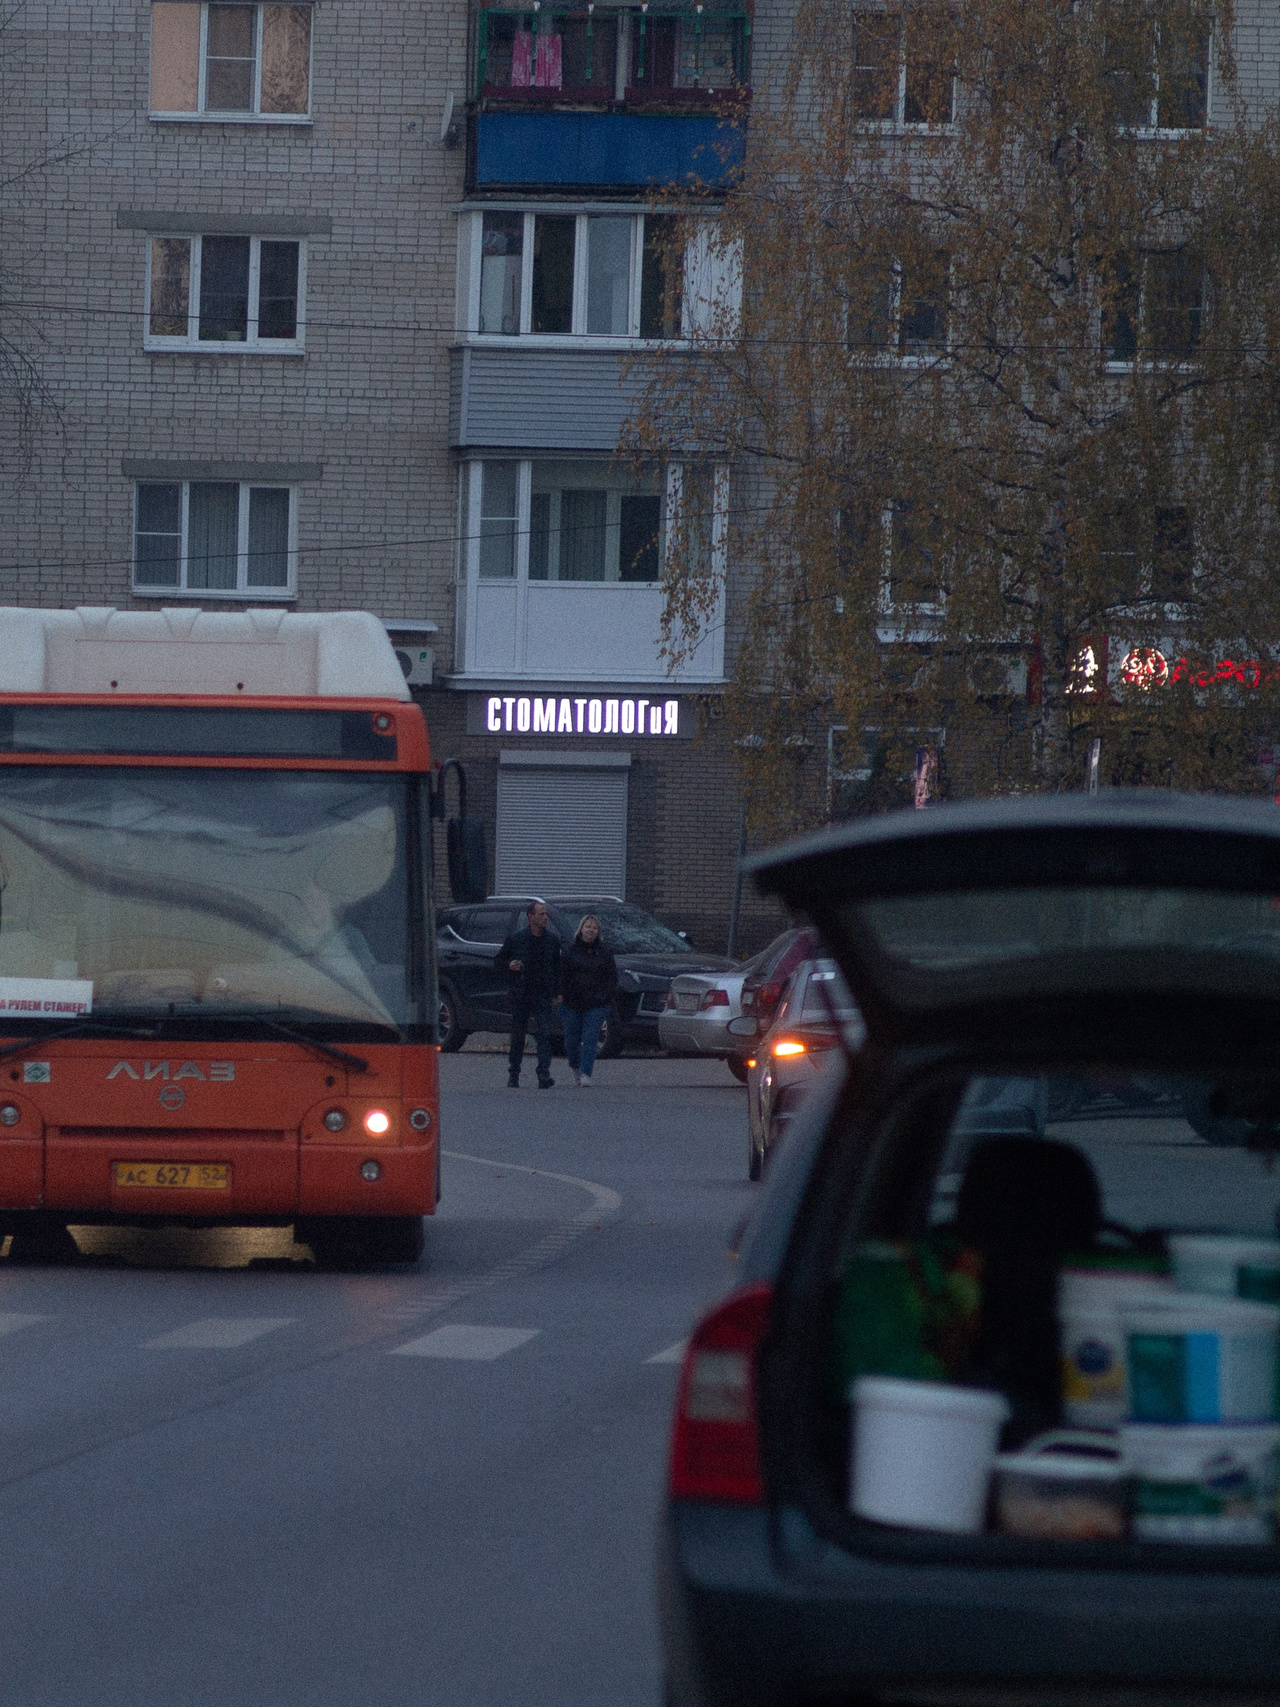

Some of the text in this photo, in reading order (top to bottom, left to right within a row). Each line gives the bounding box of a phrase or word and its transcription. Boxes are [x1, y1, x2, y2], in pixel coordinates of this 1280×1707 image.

[8, 999, 42, 1011] РУЛЕМ
[43, 1001, 88, 1013] СТАЖЕР!
[105, 1060, 236, 1082] ЛИАЗ
[155, 1166, 191, 1185] 627
[201, 1166, 221, 1180] 52
